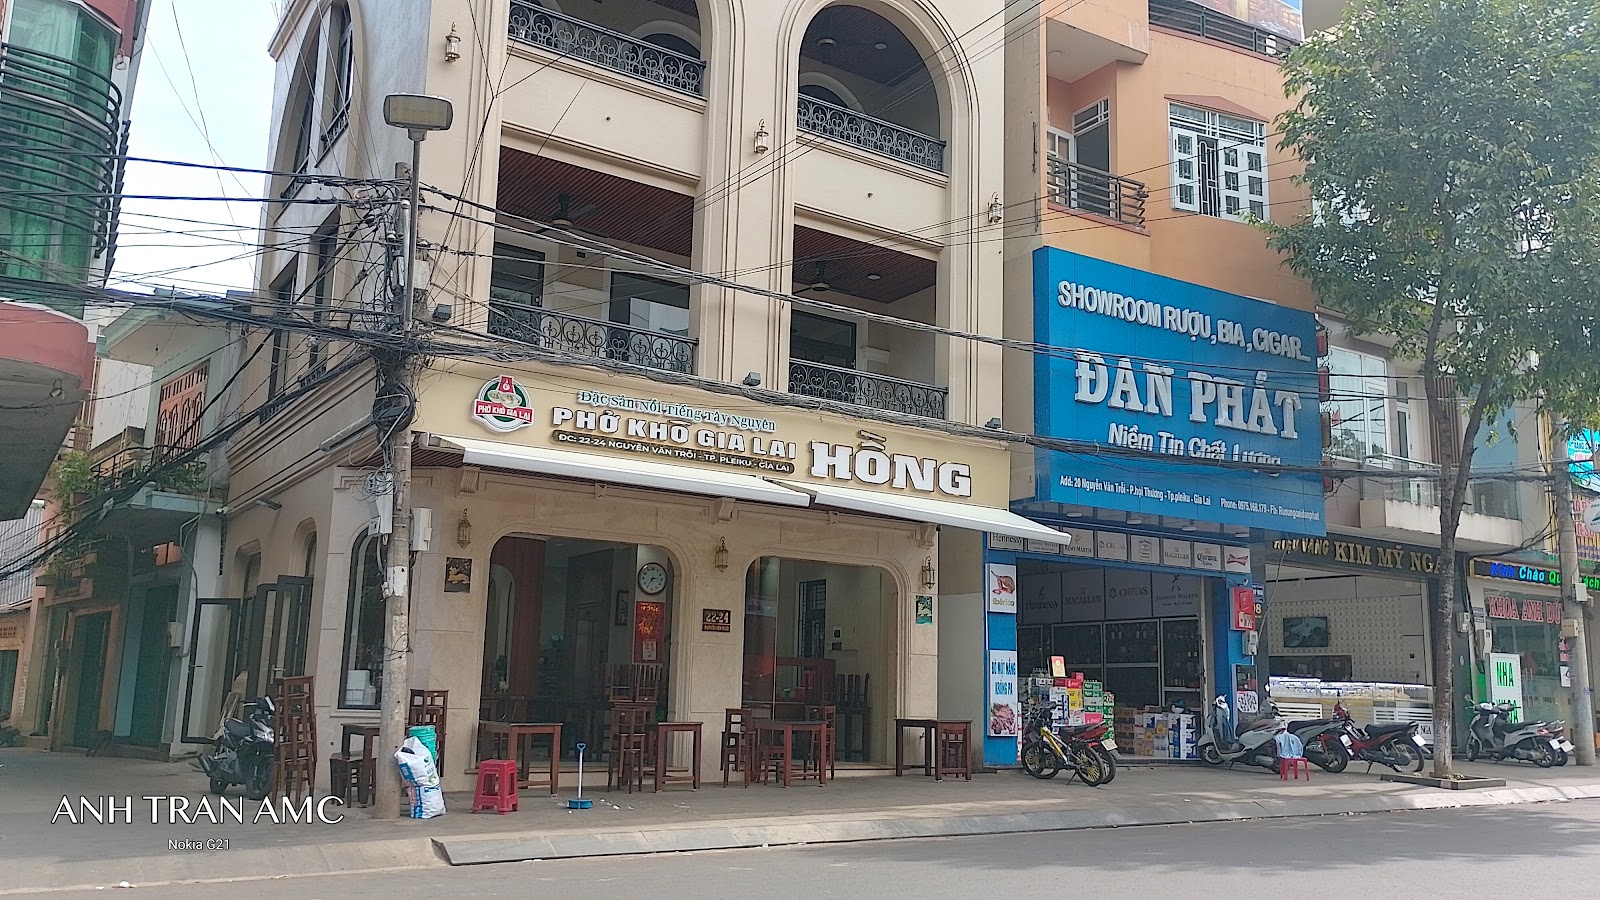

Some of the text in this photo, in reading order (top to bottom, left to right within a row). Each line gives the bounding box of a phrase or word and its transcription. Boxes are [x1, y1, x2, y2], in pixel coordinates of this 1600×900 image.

[1058, 280, 1161, 328] SHOWROOM
[519, 410, 531, 421] LAI
[579, 390, 776, 432] Đặc Sản Nổi Tiếng Tây Nguyên
[553, 406, 797, 459] PHỞ KHÔ GIA LAI
[1108, 422, 1154, 451] Niềm
[1157, 431, 1184, 456] Tin
[1187, 437, 1227, 460] Chất
[558, 433, 577, 443] ĐC:
[578, 436, 606, 446] 22-24
[608, 440, 650, 452] NGUYỄN
[651, 446, 672, 456] VĂN
[674, 448, 697, 459] TRỖI
[705, 454, 718, 462] TP.
[720, 456, 752, 467] PLEIKU
[758, 462, 774, 470] GIA
[776, 464, 790, 472] LAI
[810, 430, 972, 497] HỒNG
[1060, 475, 1073, 487] Add:
[1074, 477, 1082, 488] 20
[1082, 478, 1103, 493] Nguyễn
[1103, 481, 1115, 493] Văn
[1194, 494, 1202, 504] Gia
[1203, 495, 1211, 506] Lai
[1220, 498, 1237, 509] Phone:
[1106, 542, 1126, 550] CHAS
[1334, 541, 1372, 566] KIM
[1519, 565, 1545, 582] Chào
[1119, 587, 1148, 597] CHIVAS
[706, 611, 729, 624] 22-24
[1026, 600, 1058, 611] Hennessy
[1253, 603, 1261, 614] 8
[1488, 595, 1520, 620] KHOA
[1522, 599, 1544, 622] ANH
[1496, 662, 1514, 687] NHA
